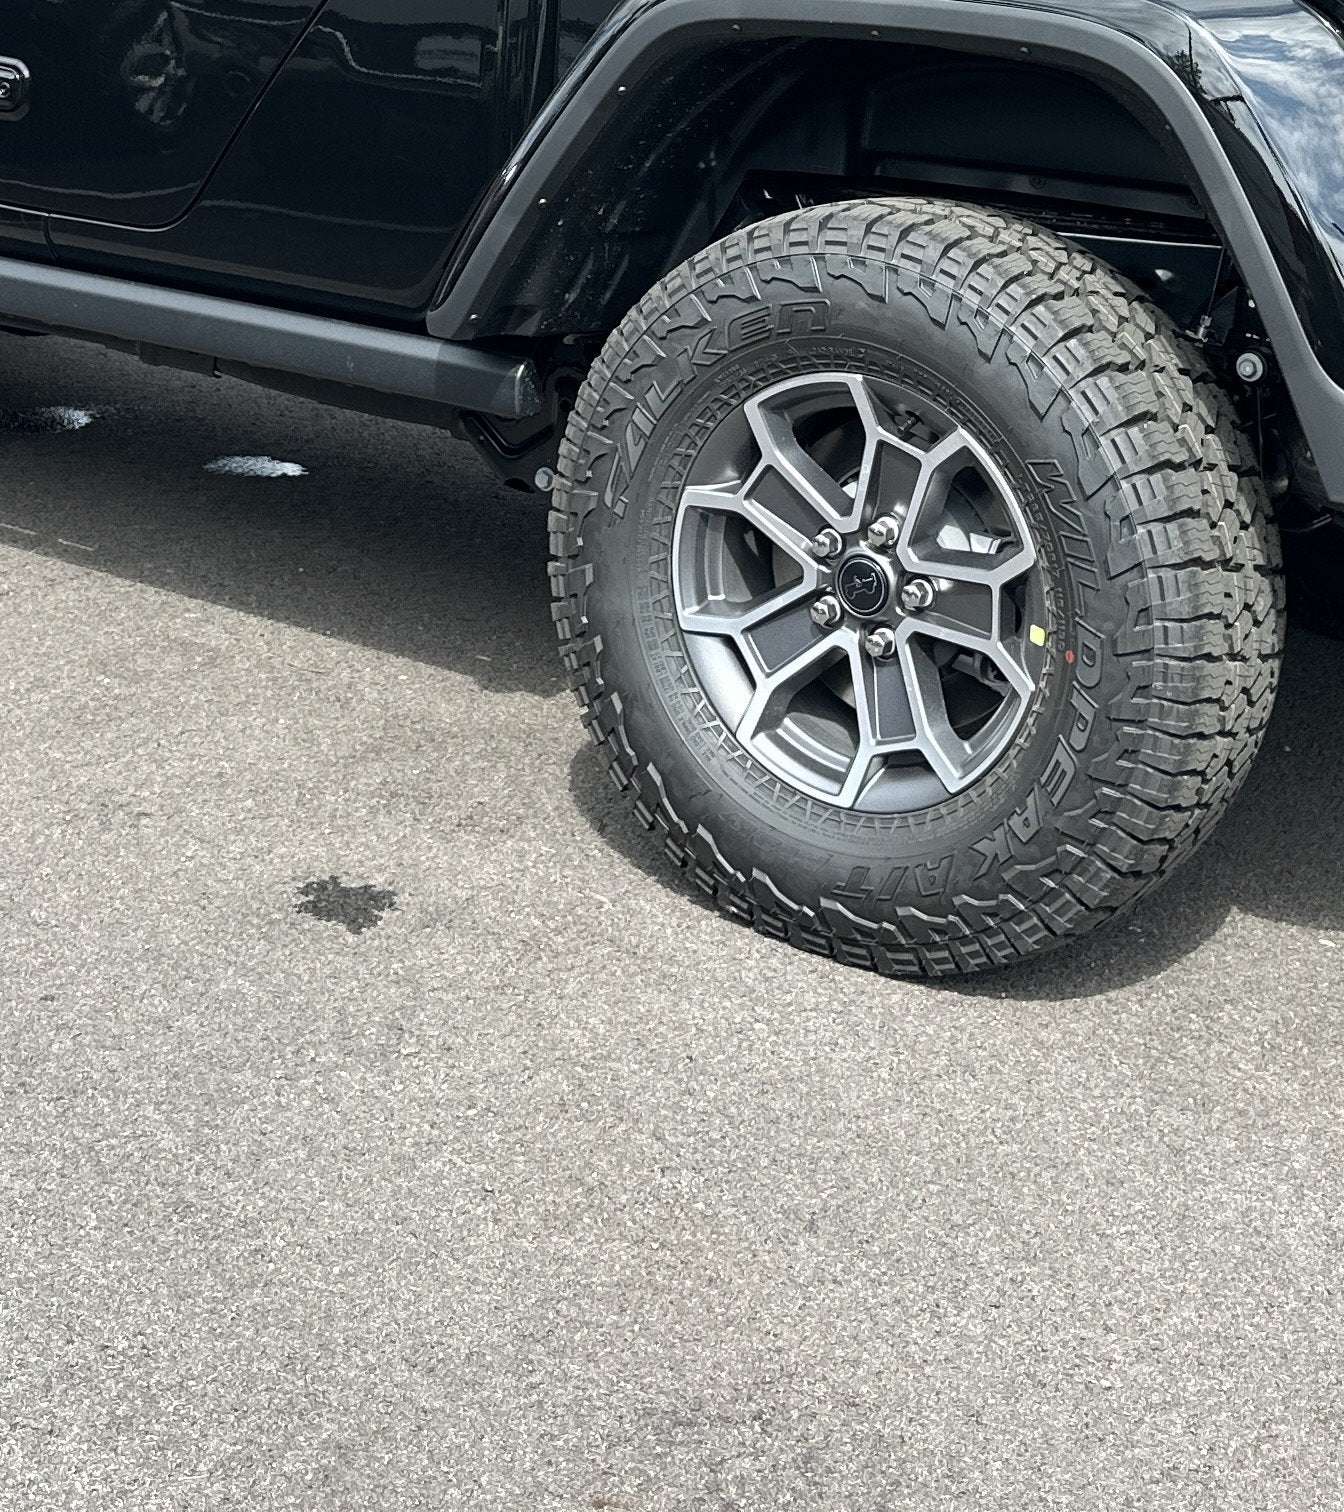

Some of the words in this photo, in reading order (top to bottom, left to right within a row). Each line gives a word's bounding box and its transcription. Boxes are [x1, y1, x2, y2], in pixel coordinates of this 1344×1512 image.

[604, 298, 832, 520] FALKEN
[967, 457, 1106, 883] WILDPEAK
[830, 850, 958, 903] A/T
